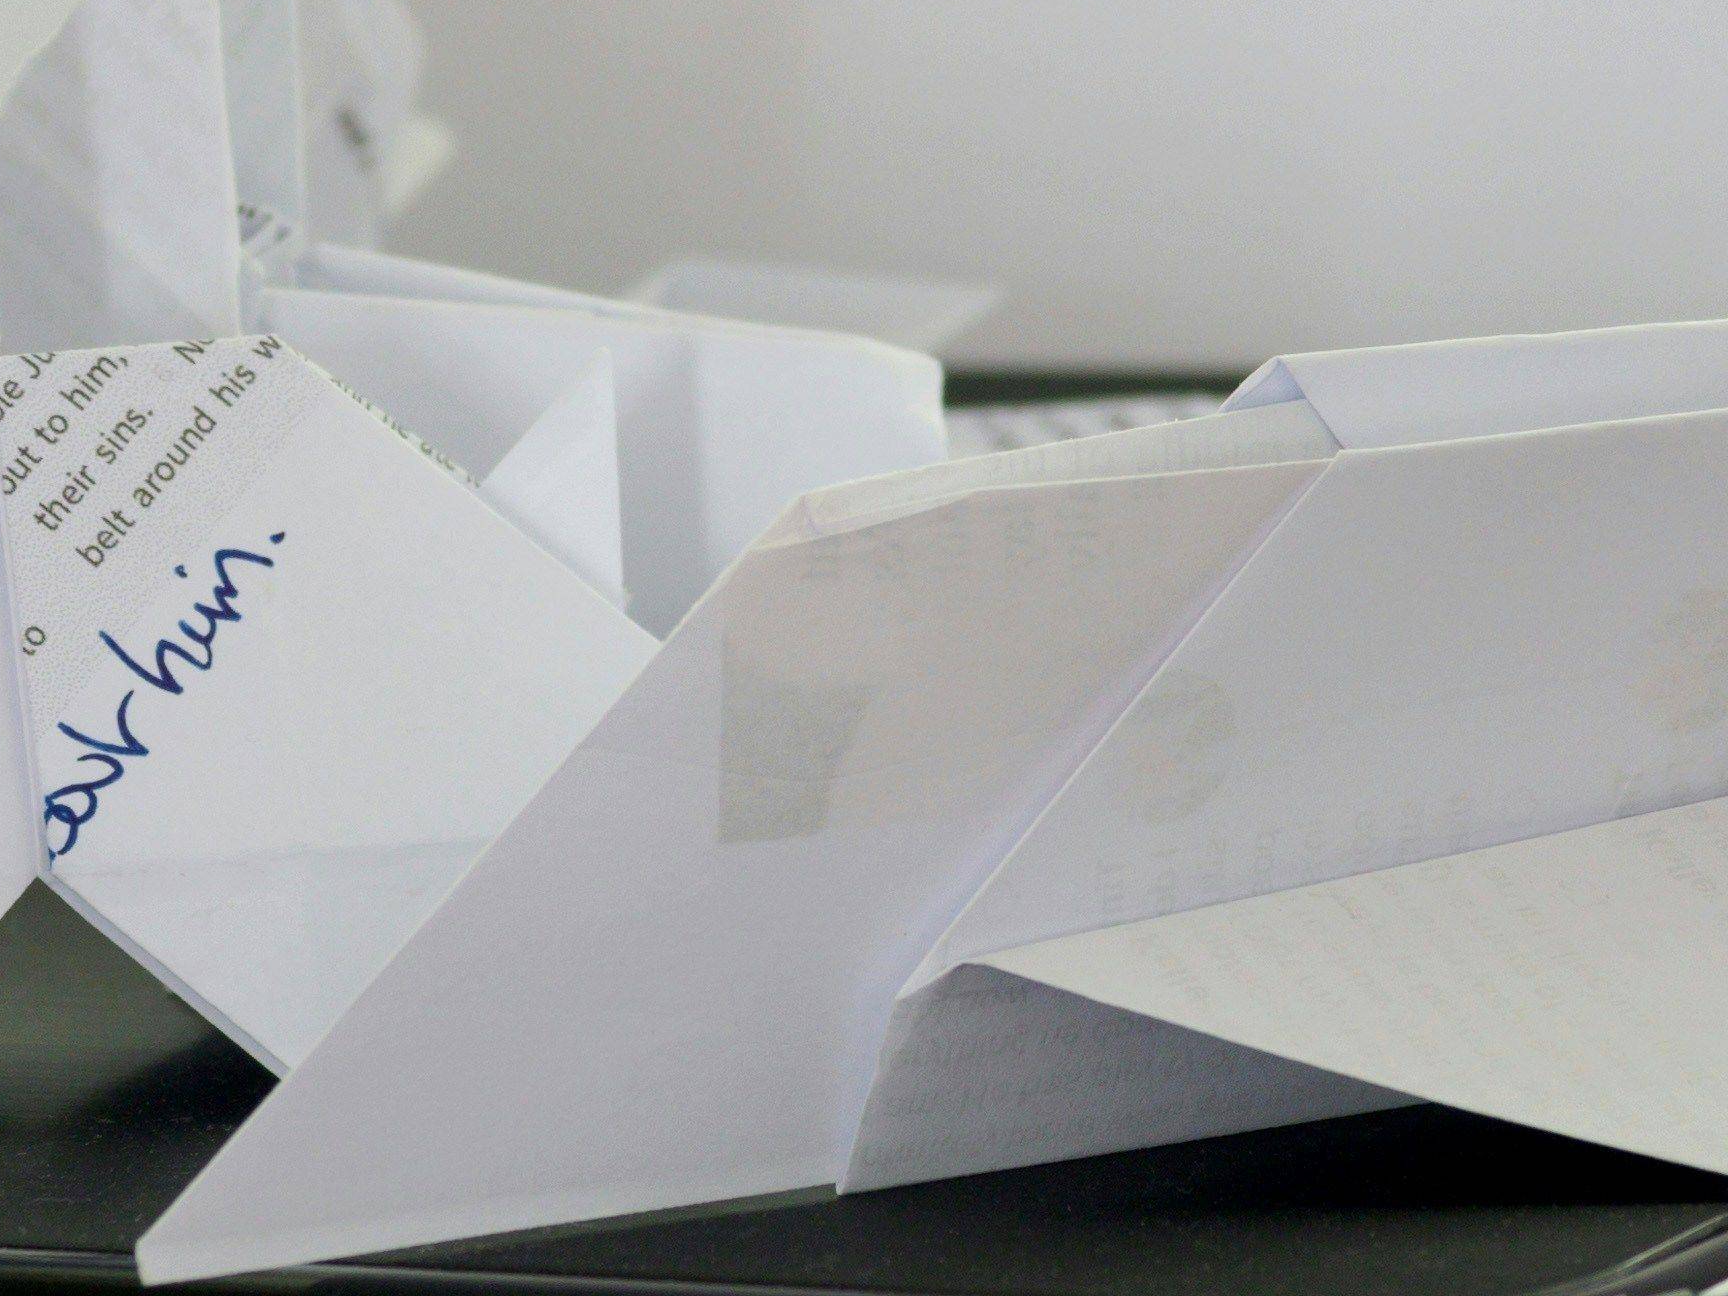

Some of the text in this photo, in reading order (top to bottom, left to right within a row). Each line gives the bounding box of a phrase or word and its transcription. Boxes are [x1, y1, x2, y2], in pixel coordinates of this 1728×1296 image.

[35, 413, 69, 445] to
[65, 354, 130, 411] him,
[34, 466, 98, 532] their
[96, 407, 154, 466] sins.
[75, 509, 136, 567] belt
[134, 405, 218, 509] around
[210, 361, 257, 408] his
